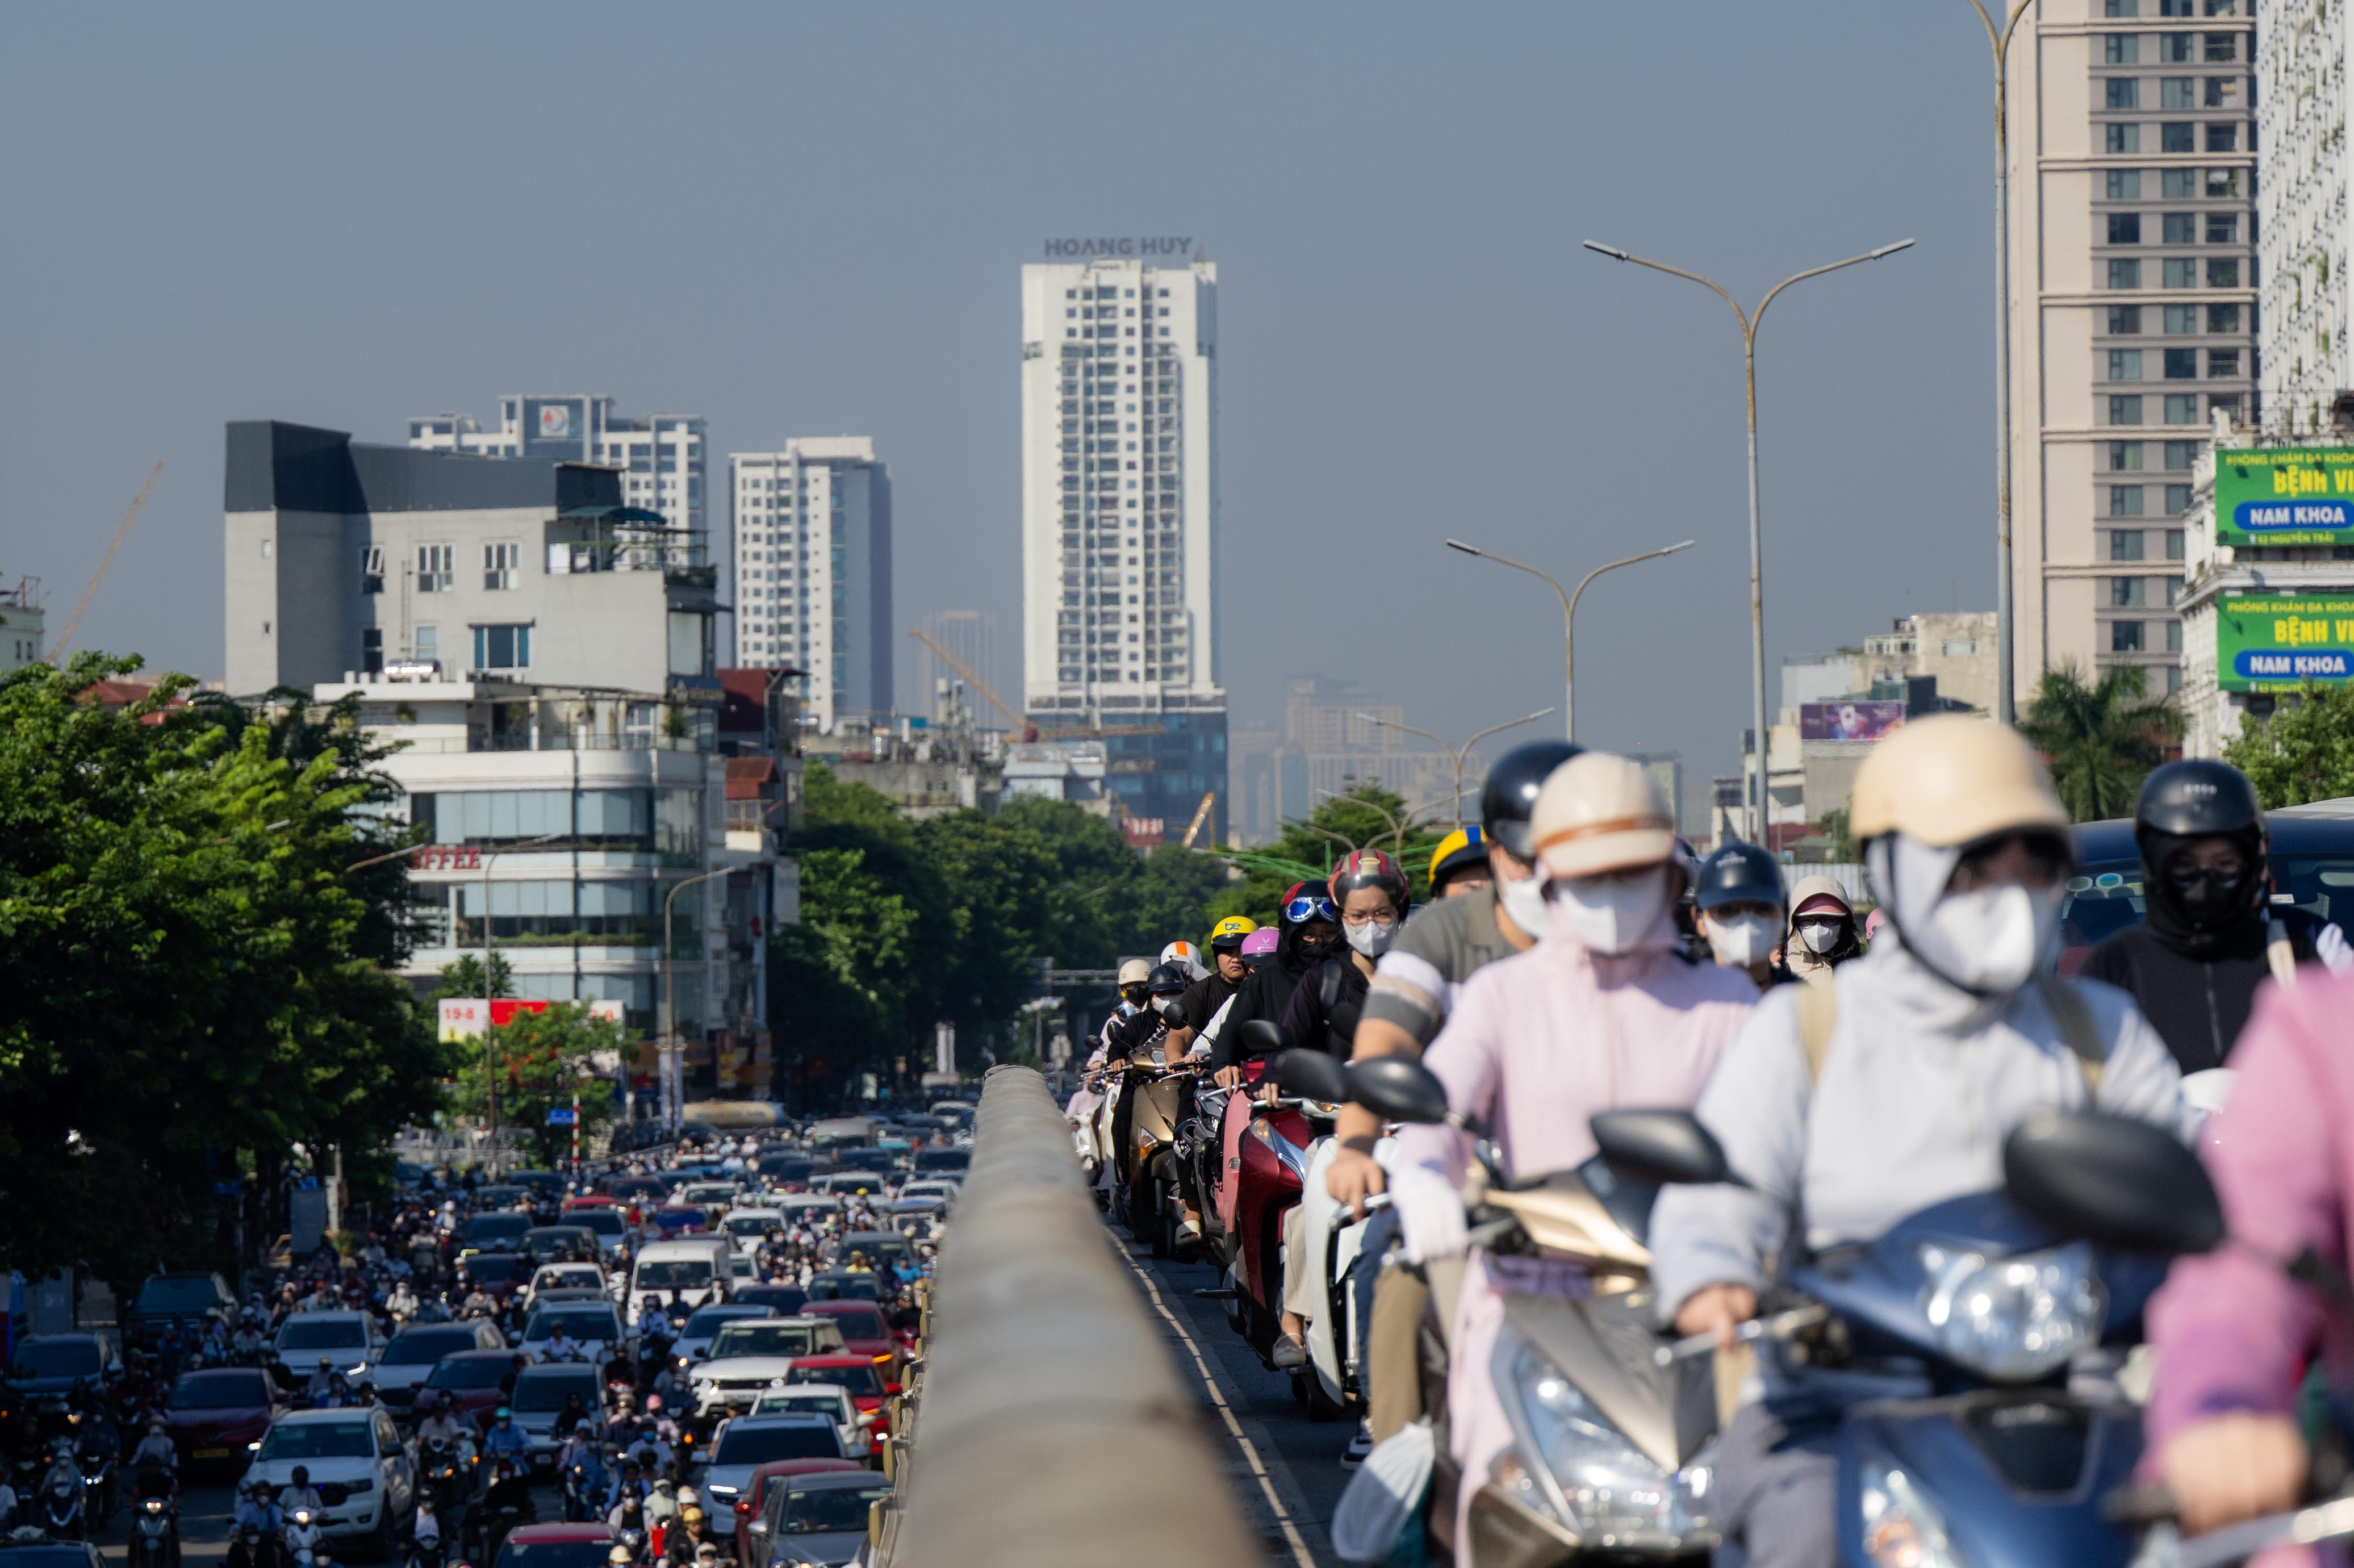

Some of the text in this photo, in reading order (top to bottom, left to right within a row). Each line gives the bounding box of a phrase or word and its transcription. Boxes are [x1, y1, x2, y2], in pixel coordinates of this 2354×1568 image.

[1044, 236, 1192, 256] HOANG HUY
[2250, 506, 2345, 526] NAM KHOA
[2274, 615, 2328, 647] BỆNH
[2250, 656, 2346, 674] NAM KHOA
[1224, 922, 1241, 931] be
